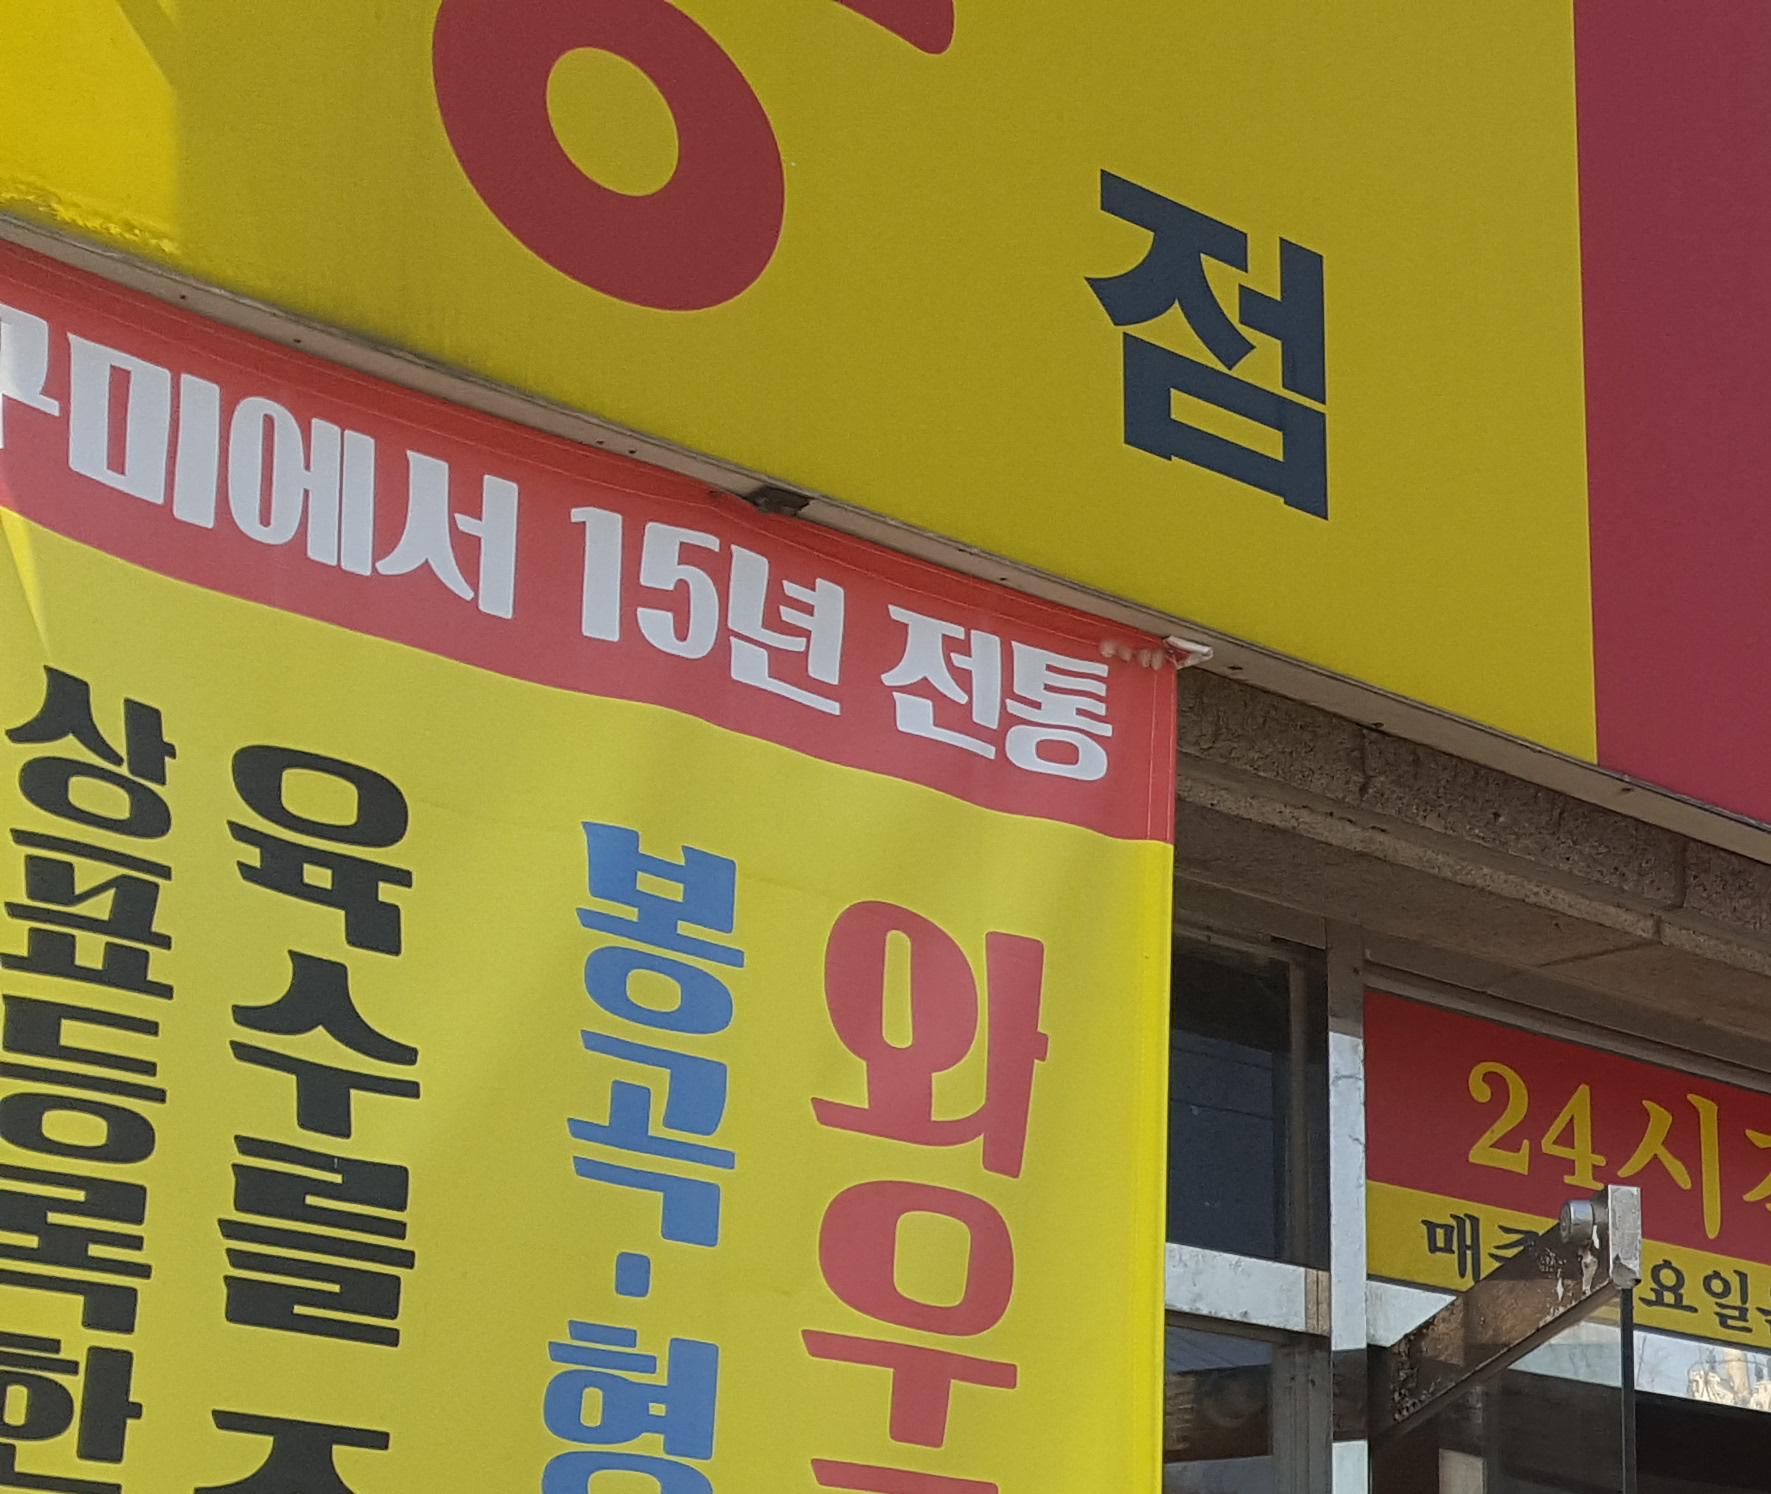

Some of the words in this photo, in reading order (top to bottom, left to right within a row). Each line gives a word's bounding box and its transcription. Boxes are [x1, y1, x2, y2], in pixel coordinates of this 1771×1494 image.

[1083, 167, 1329, 521] 점
[571, 506, 845, 715] 15년
[882, 604, 1114, 781] 전통
[215, 743, 420, 1348] 육수를
